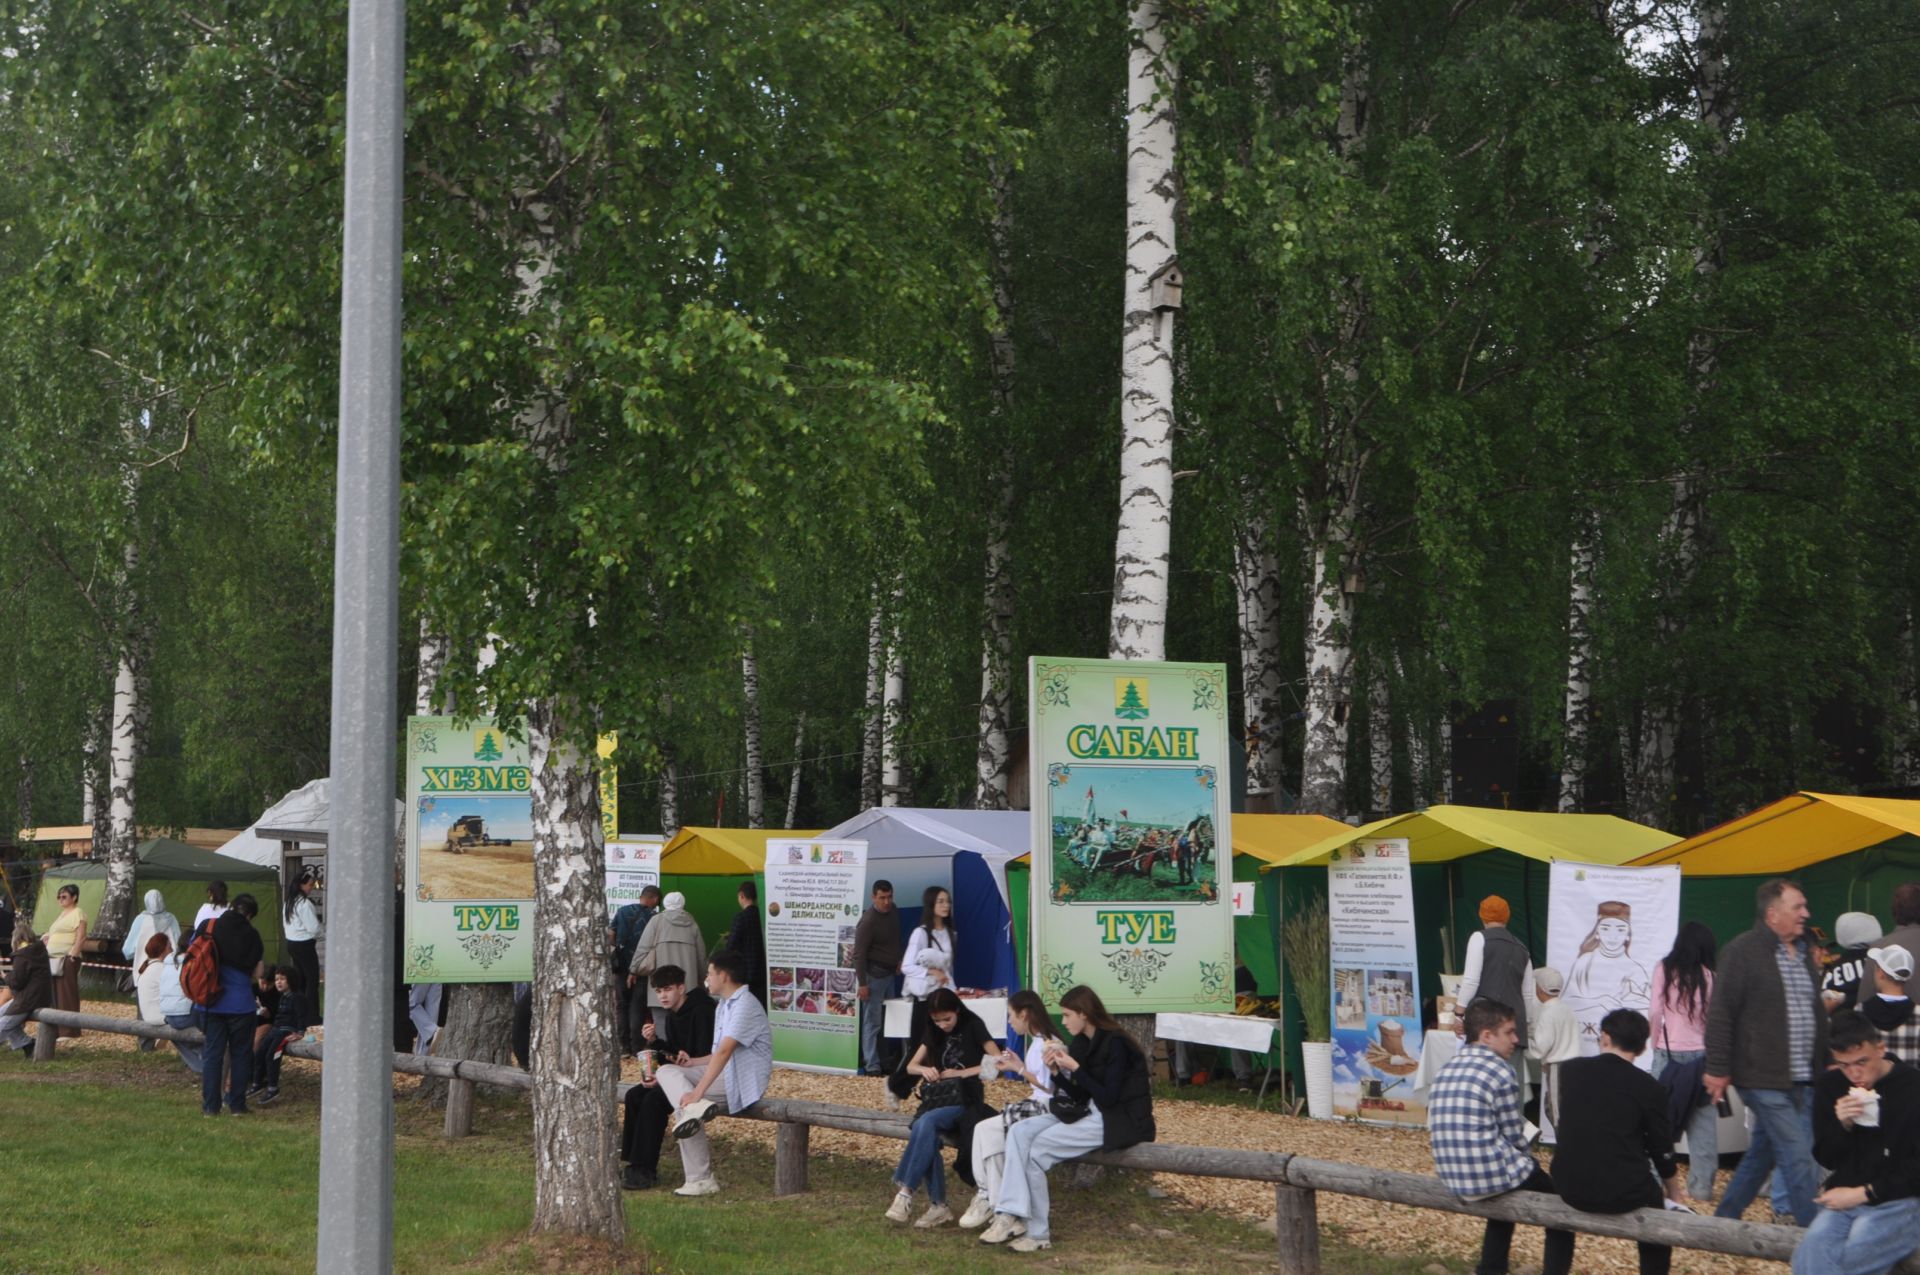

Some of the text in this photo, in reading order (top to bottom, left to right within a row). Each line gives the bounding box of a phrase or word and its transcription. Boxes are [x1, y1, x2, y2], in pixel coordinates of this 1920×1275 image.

[1067, 724, 1199, 760] САБАН
[422, 766, 532, 791] ХЕЗМӘ
[454, 905, 520, 931] ТУЕ
[784, 901, 843, 910] ШЕМОРДАНСКИЕ
[791, 911, 835, 919] ДЕЛИКАТЕСЫ
[1096, 910, 1176, 944] ТУЕ
